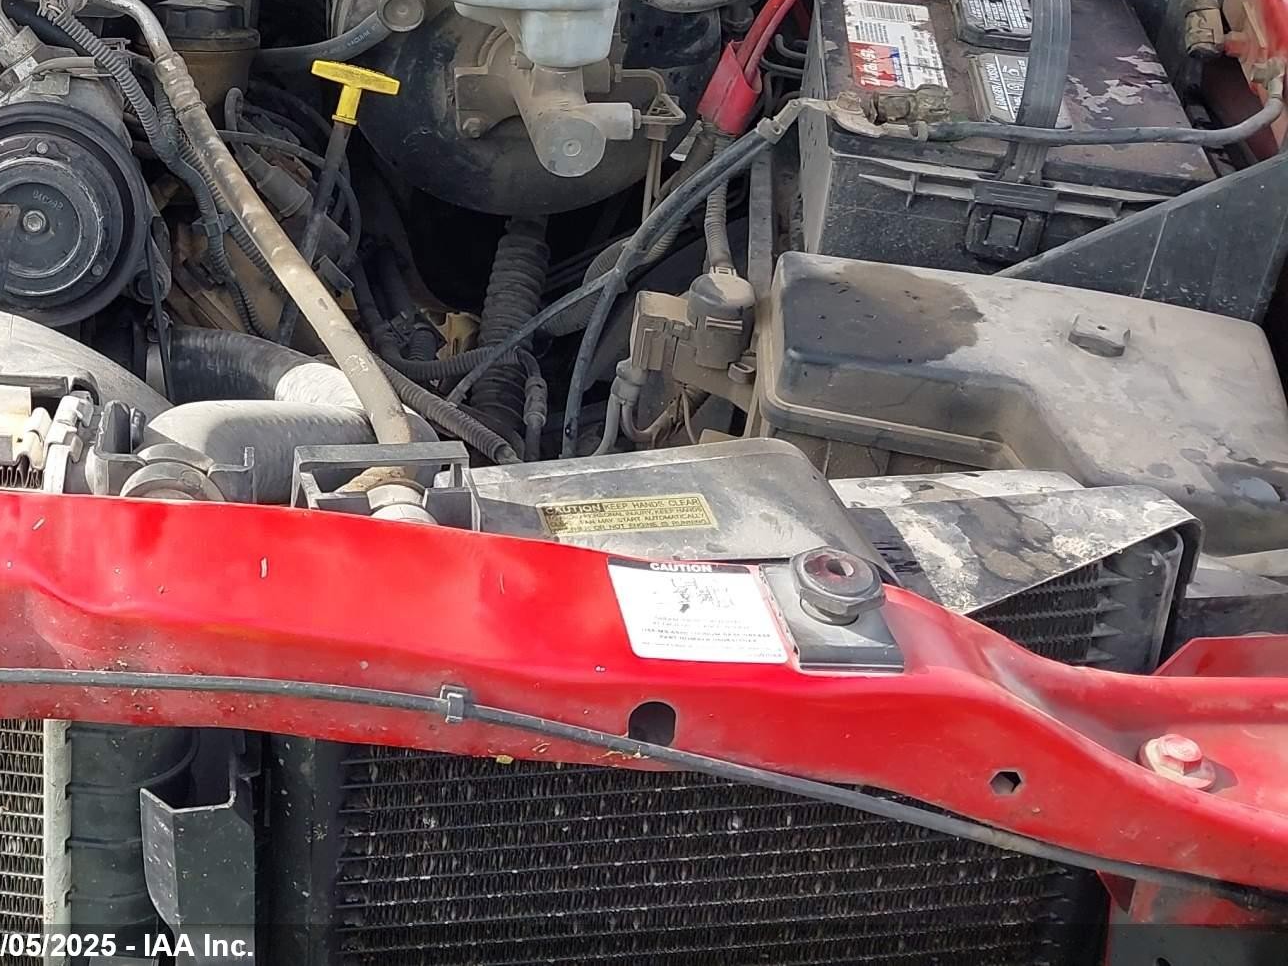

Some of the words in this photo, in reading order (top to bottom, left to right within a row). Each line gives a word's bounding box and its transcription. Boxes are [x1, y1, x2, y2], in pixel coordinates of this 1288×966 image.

[545, 504, 601, 515] CAUTION
[604, 502, 629, 511] KEEP
[631, 500, 665, 509] HANDS
[668, 498, 699, 507] CLEAR
[649, 562, 713, 573] CAUTION
